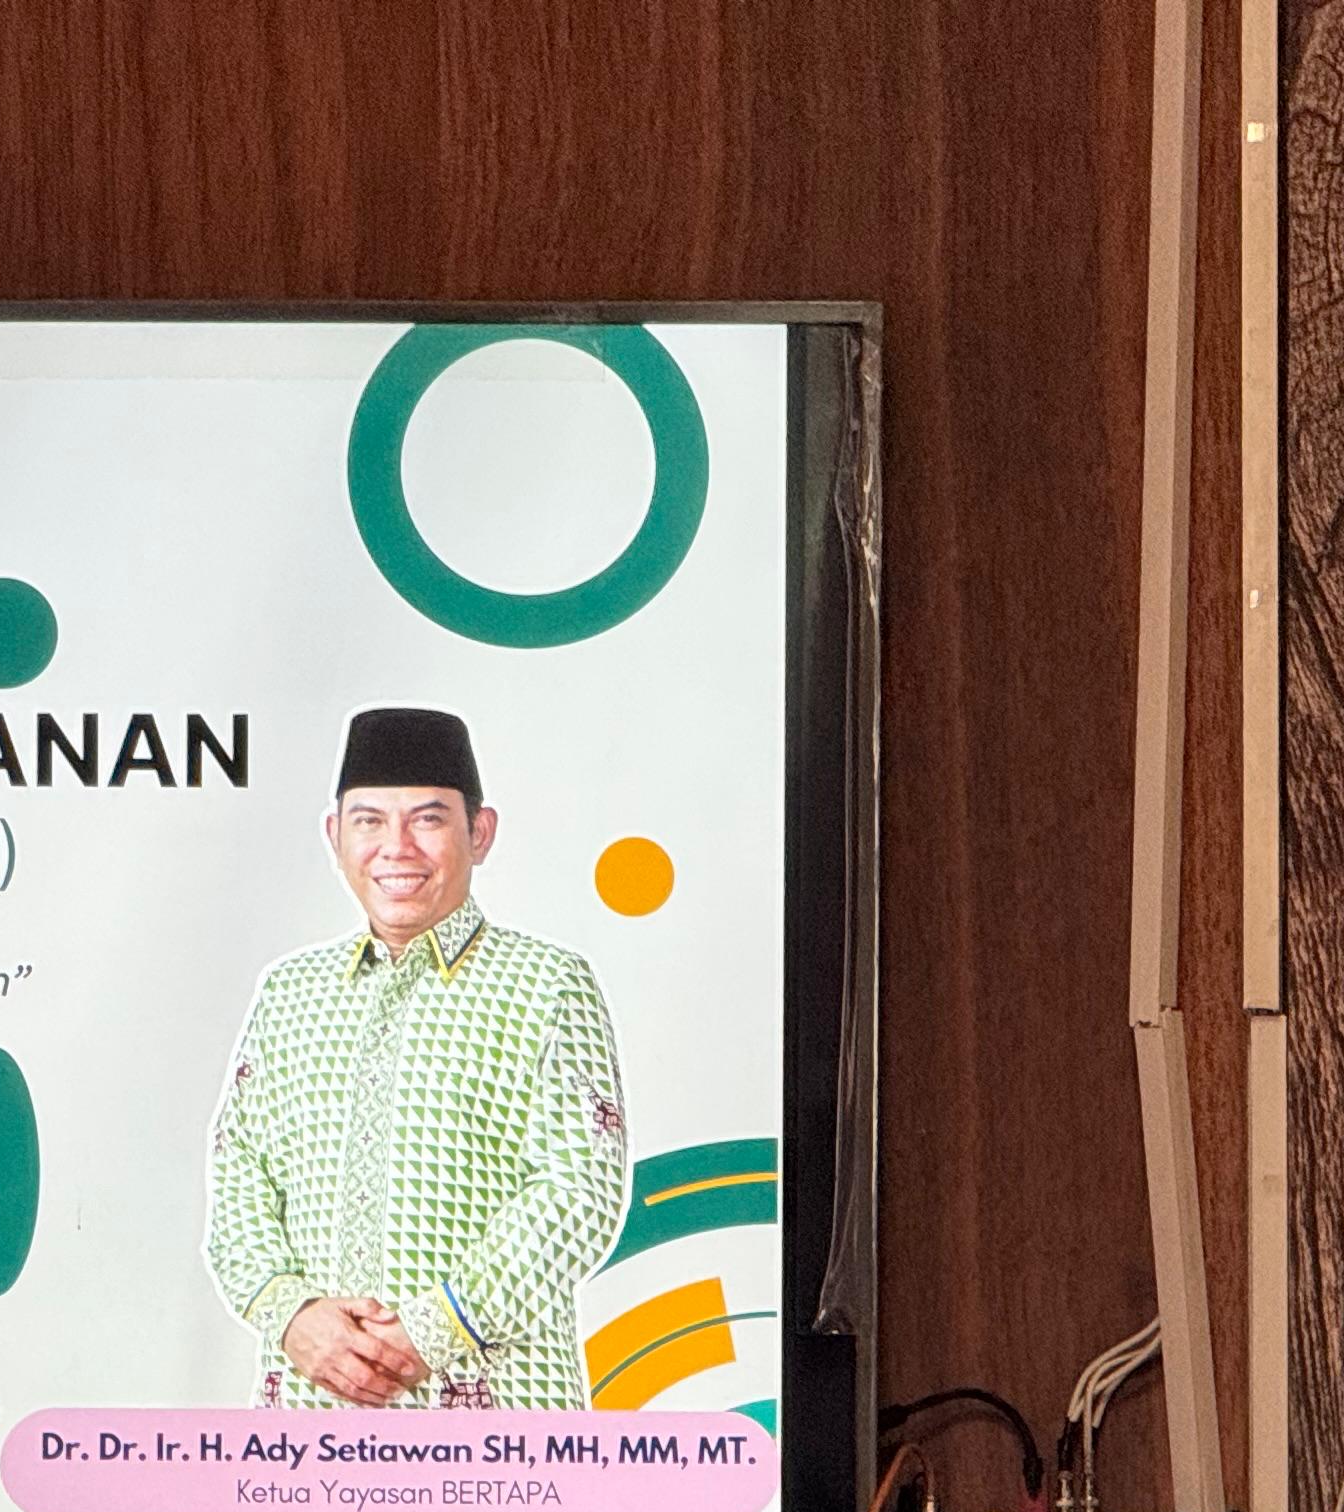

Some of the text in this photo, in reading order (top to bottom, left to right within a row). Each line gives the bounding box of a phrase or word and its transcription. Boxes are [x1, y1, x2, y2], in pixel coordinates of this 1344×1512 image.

[42, 1432, 756, 1471] Dr. Dr. Ir. H. Ady Setiawan SH, MH, MM, MT.
[237, 1478, 562, 1512] Ketua Yayasan BERTAPA
